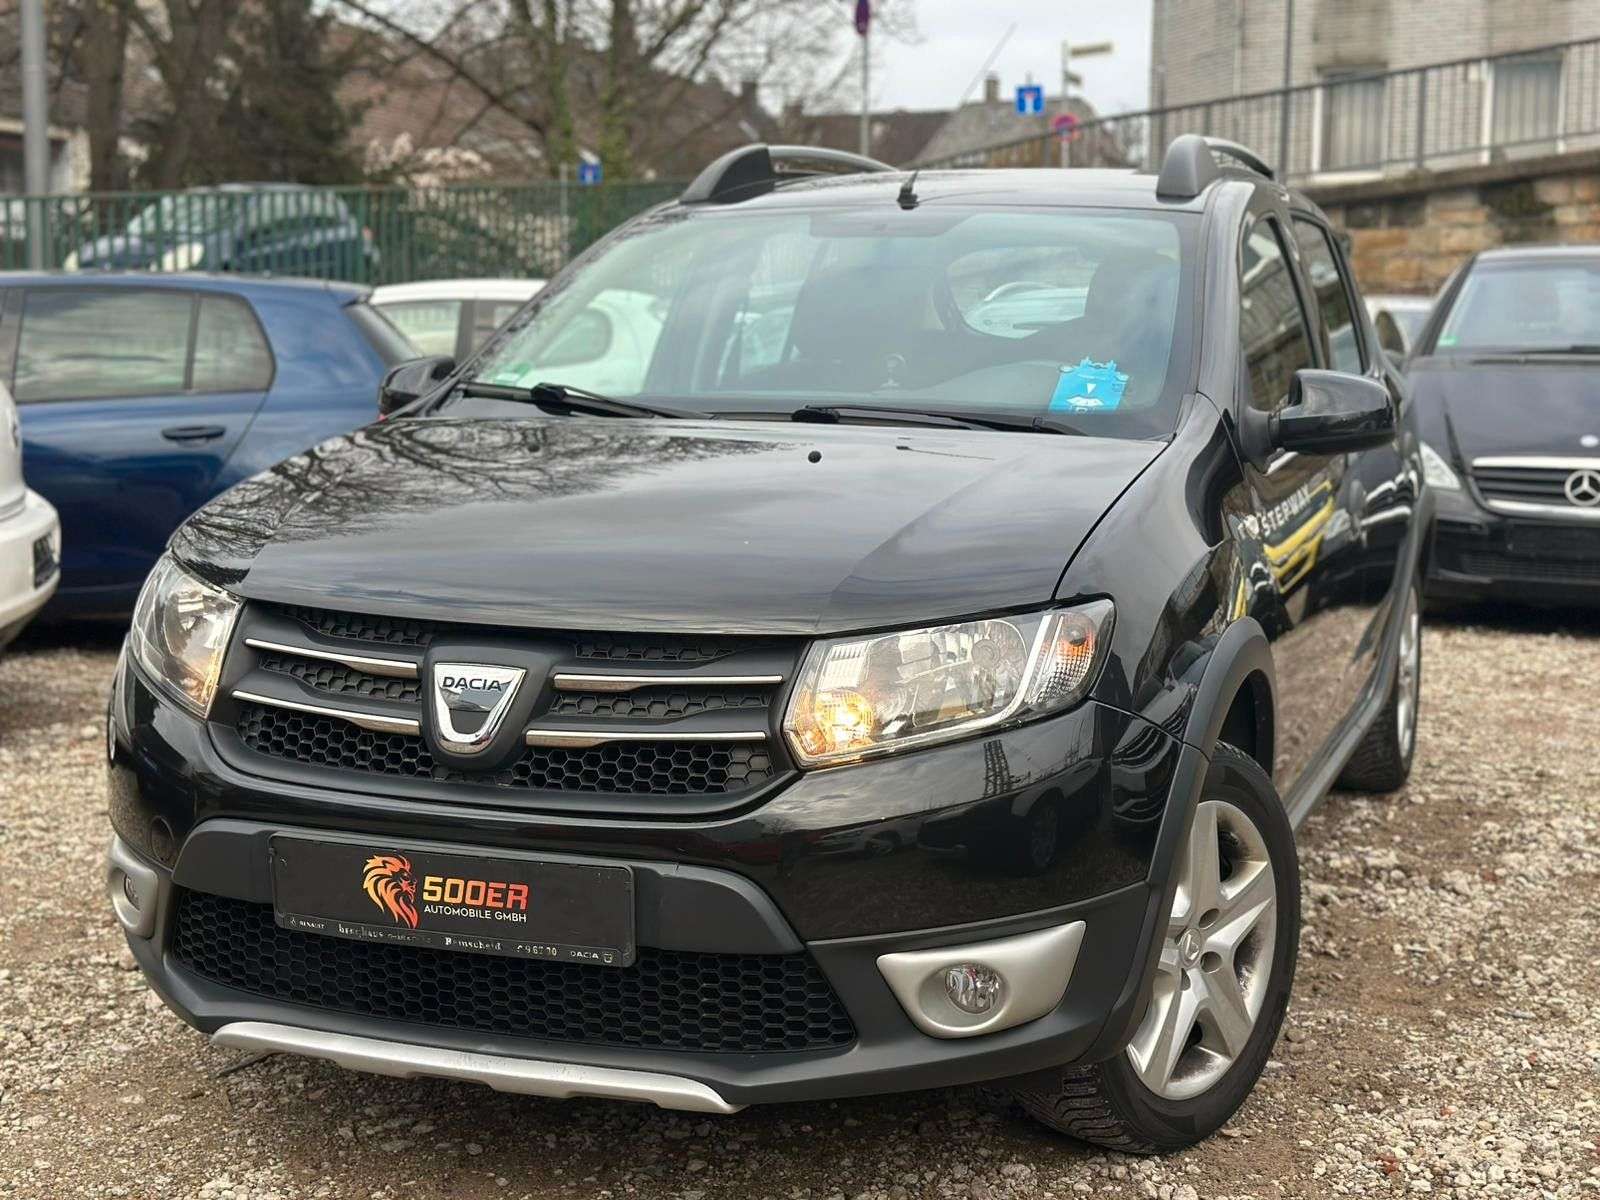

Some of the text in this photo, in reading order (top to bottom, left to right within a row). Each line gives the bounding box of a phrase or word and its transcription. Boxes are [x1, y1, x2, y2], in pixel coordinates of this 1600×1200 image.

[443, 676, 502, 692] DACIA
[424, 904, 527, 922] AUTOMOBILE GMBH
